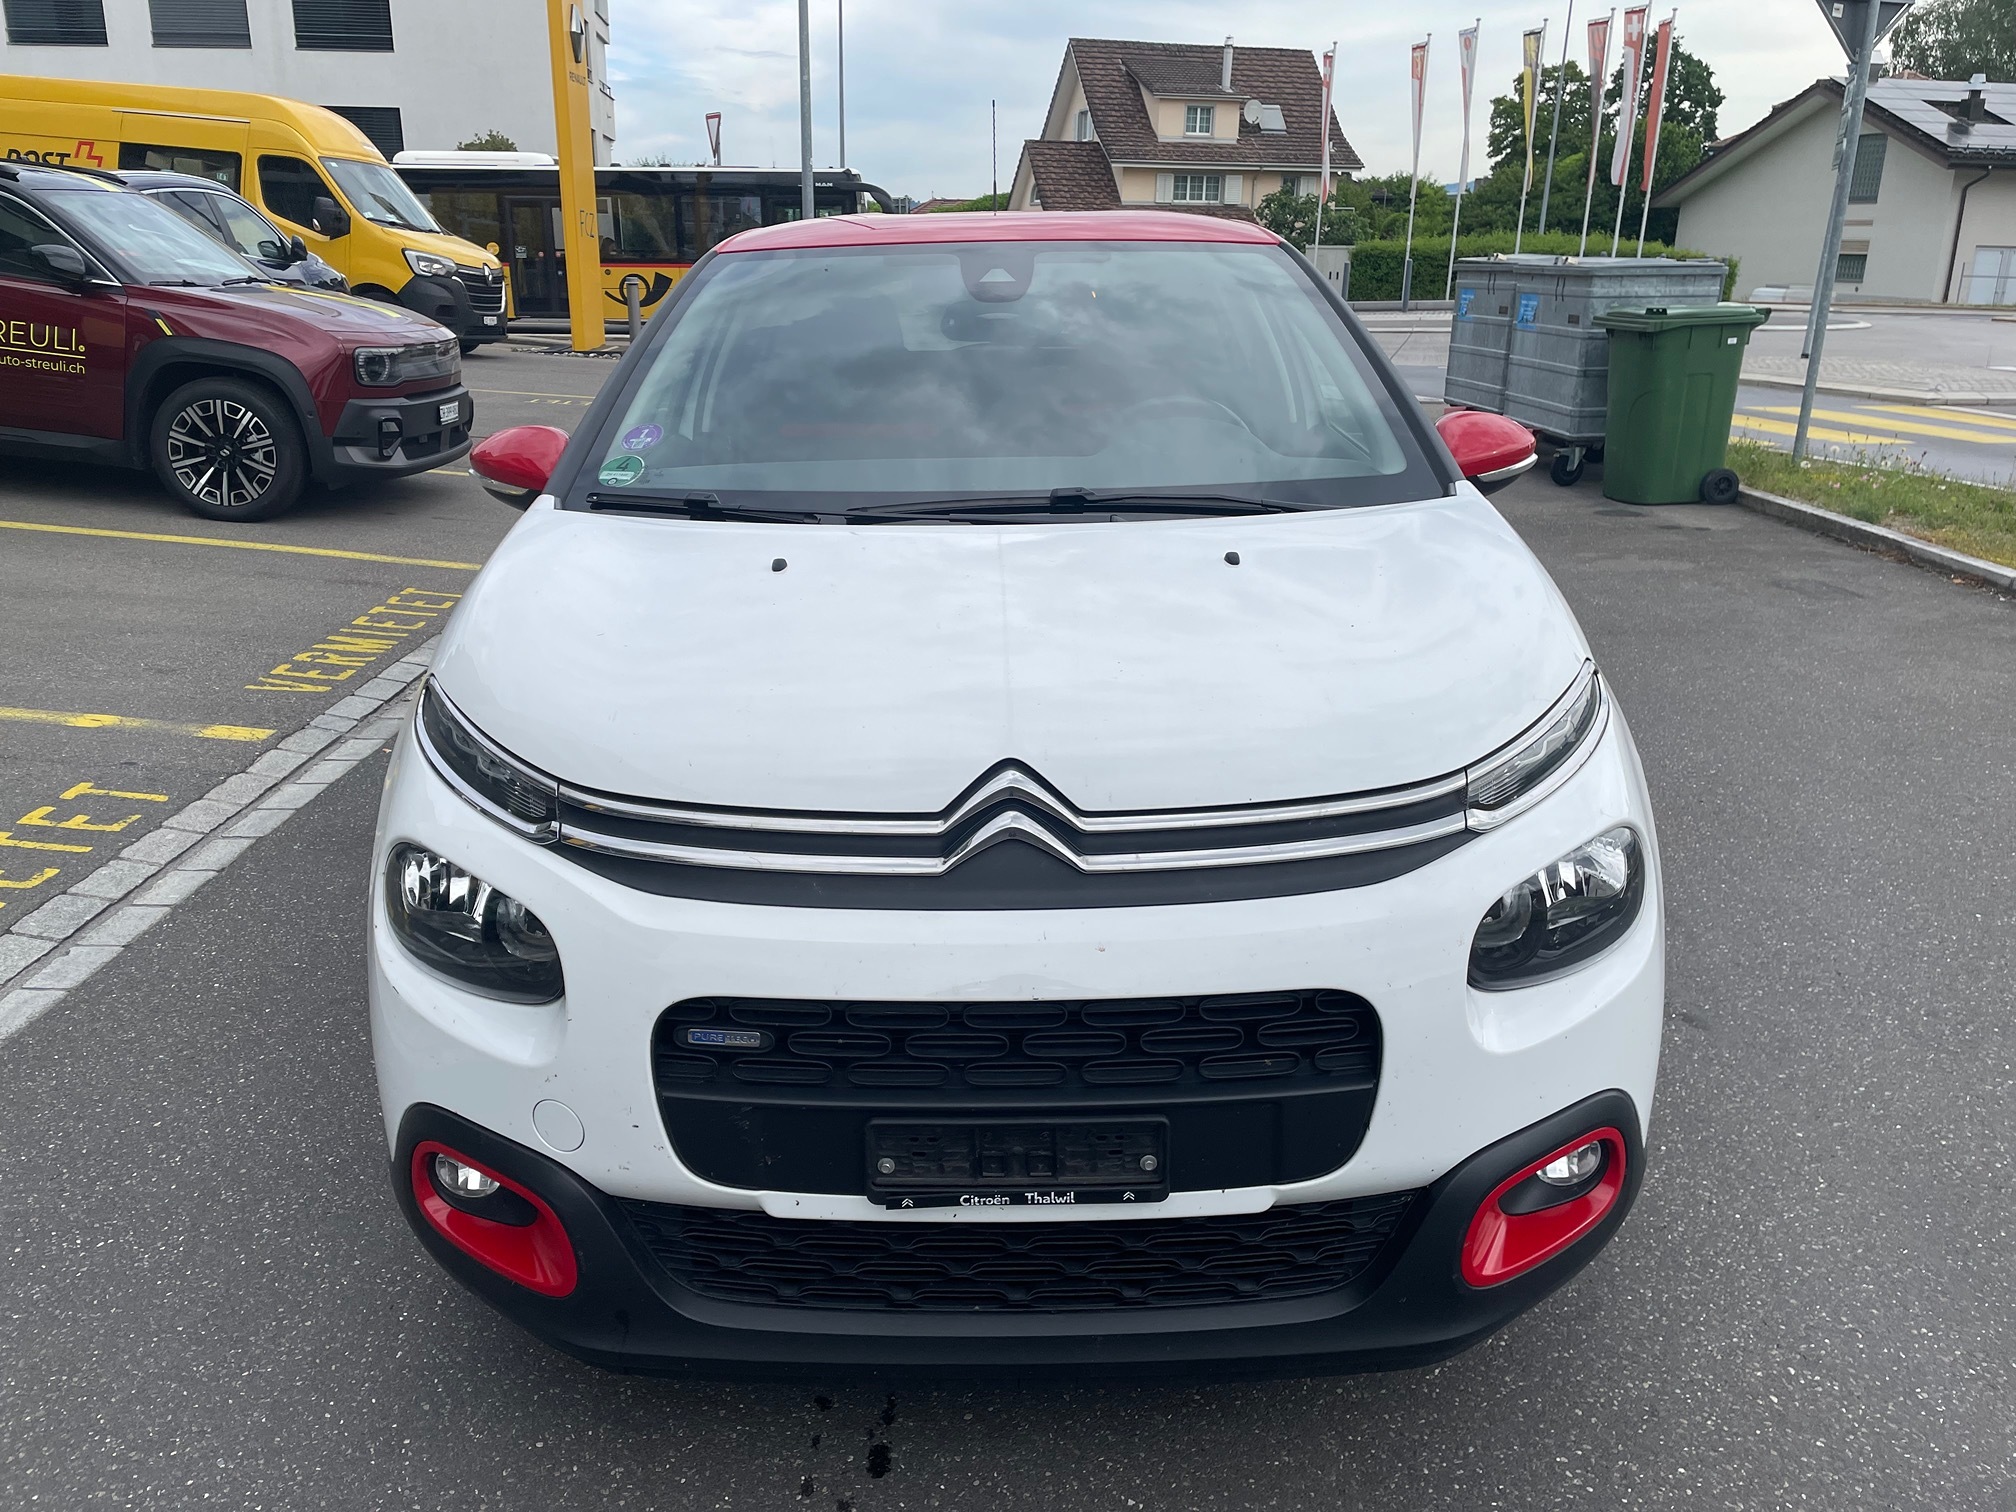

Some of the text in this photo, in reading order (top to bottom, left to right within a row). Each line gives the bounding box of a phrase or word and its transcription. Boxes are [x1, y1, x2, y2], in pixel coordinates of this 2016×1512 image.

[615, 456, 632, 472] 4
[244, 587, 463, 692] VERMIETET
[960, 1191, 1075, 1206] Citroën Thalwil
